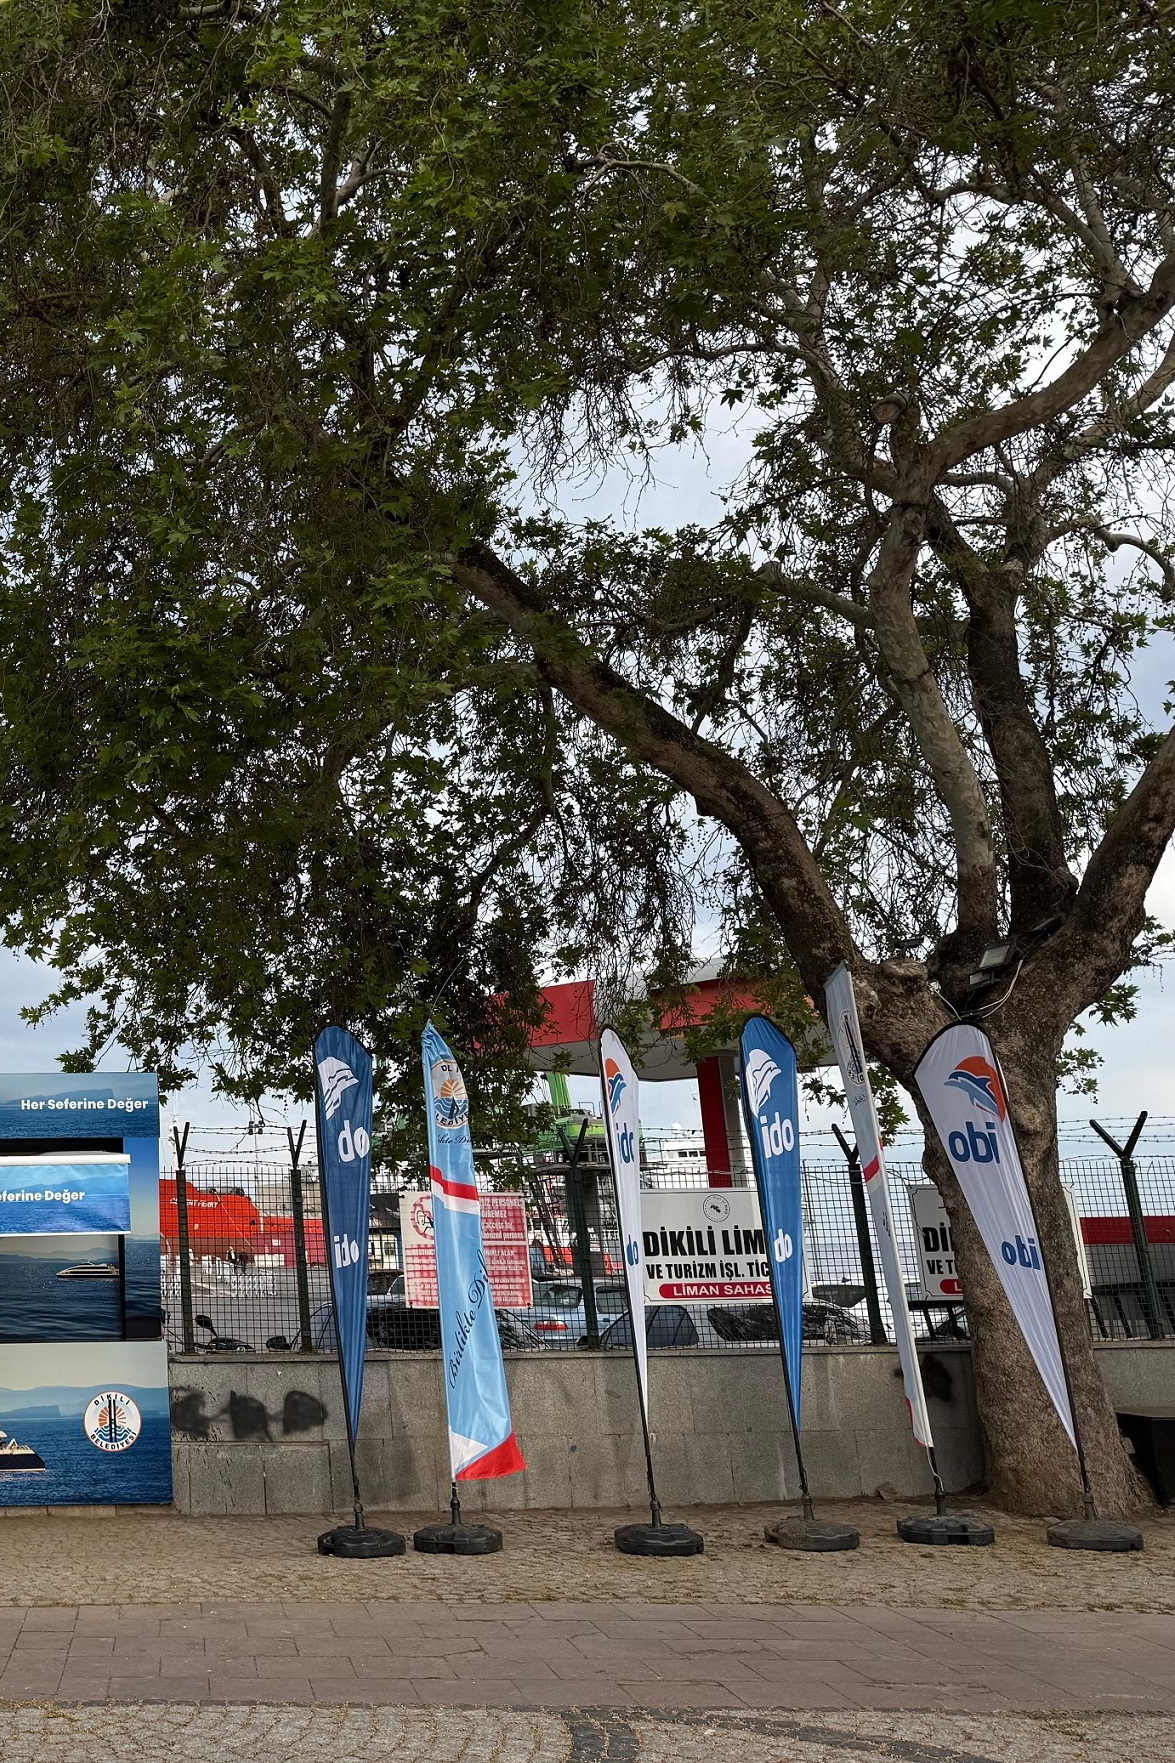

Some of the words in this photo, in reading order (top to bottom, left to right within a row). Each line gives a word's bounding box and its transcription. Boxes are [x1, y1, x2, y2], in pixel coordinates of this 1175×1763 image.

[21, 1099, 45, 1110] Her
[48, 1098, 104, 1110] Seferine
[107, 1096, 148, 1112] Değer
[338, 1119, 370, 1163] do
[760, 1112, 795, 1158] ido
[44, 1188, 85, 1204] Değer
[626, 1234, 639, 1266] do
[642, 1225, 717, 1257] DİKİLİ
[723, 1225, 766, 1255] LİM
[774, 1229, 793, 1263] do
[646, 1264, 662, 1279] VE
[665, 1261, 717, 1279] TURİZM
[719, 1260, 745, 1281] İŞL.
[926, 1259, 944, 1275] VE
[673, 1284, 720, 1297] LİMAN
[724, 1284, 772, 1295] SAHAS
